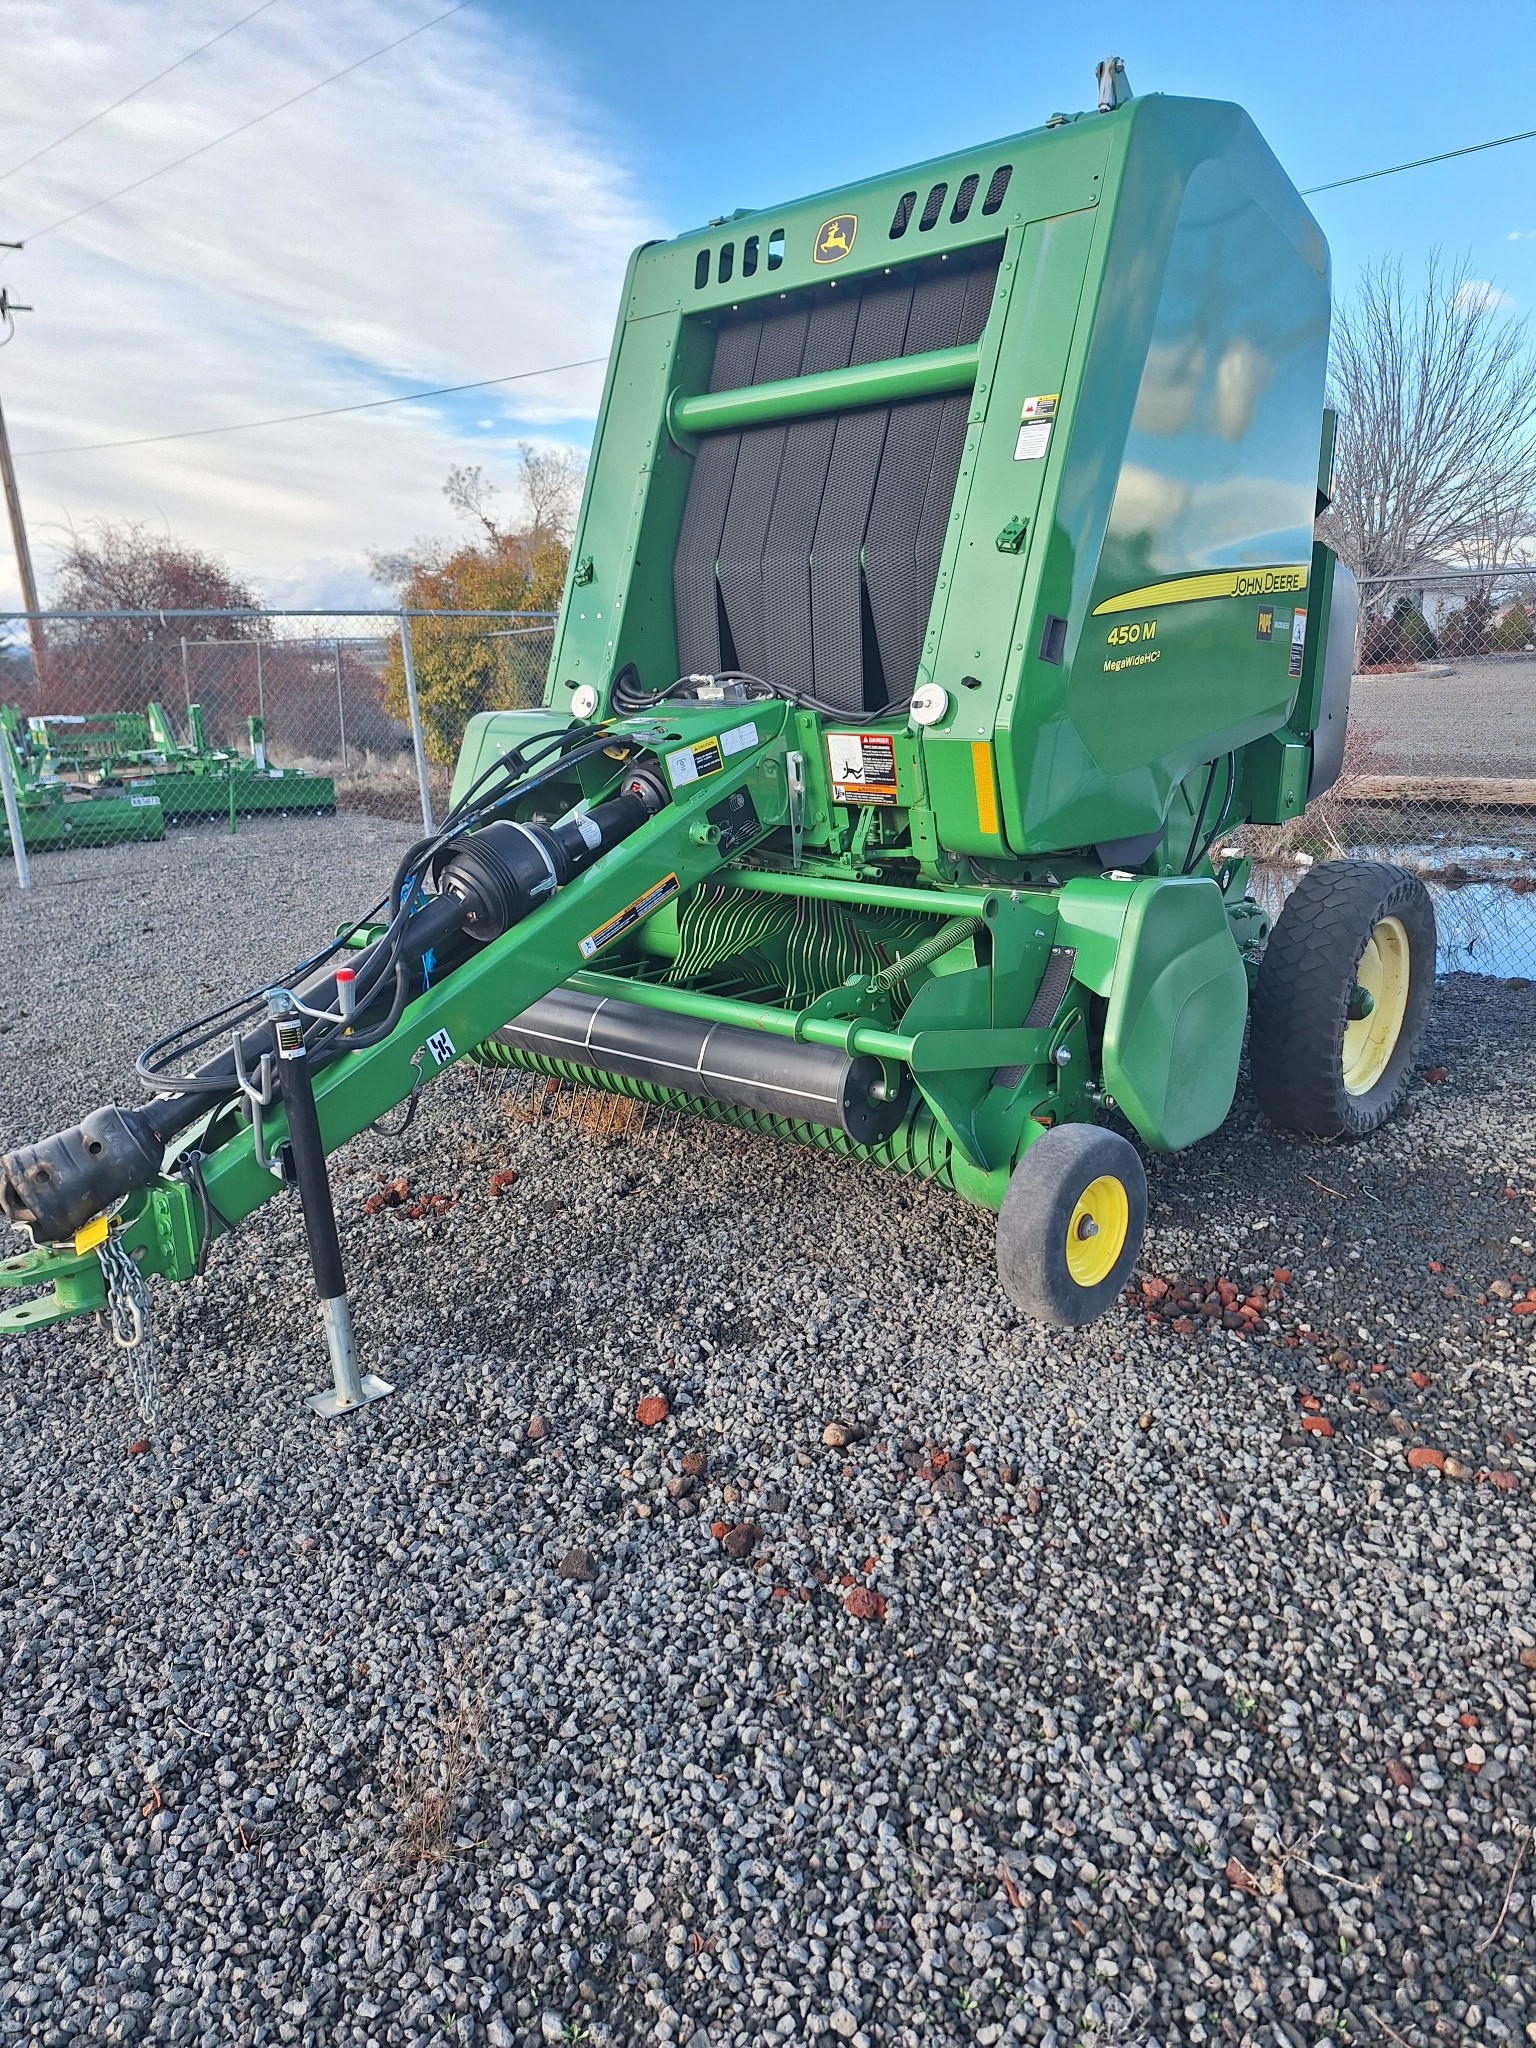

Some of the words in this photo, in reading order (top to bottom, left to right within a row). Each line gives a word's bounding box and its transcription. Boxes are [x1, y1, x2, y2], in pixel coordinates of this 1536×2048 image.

[1231, 576, 1263, 594] JOHN
[1265, 573, 1300, 591] DEERE
[1107, 624, 1141, 646] 450
[1142, 620, 1157, 641] M
